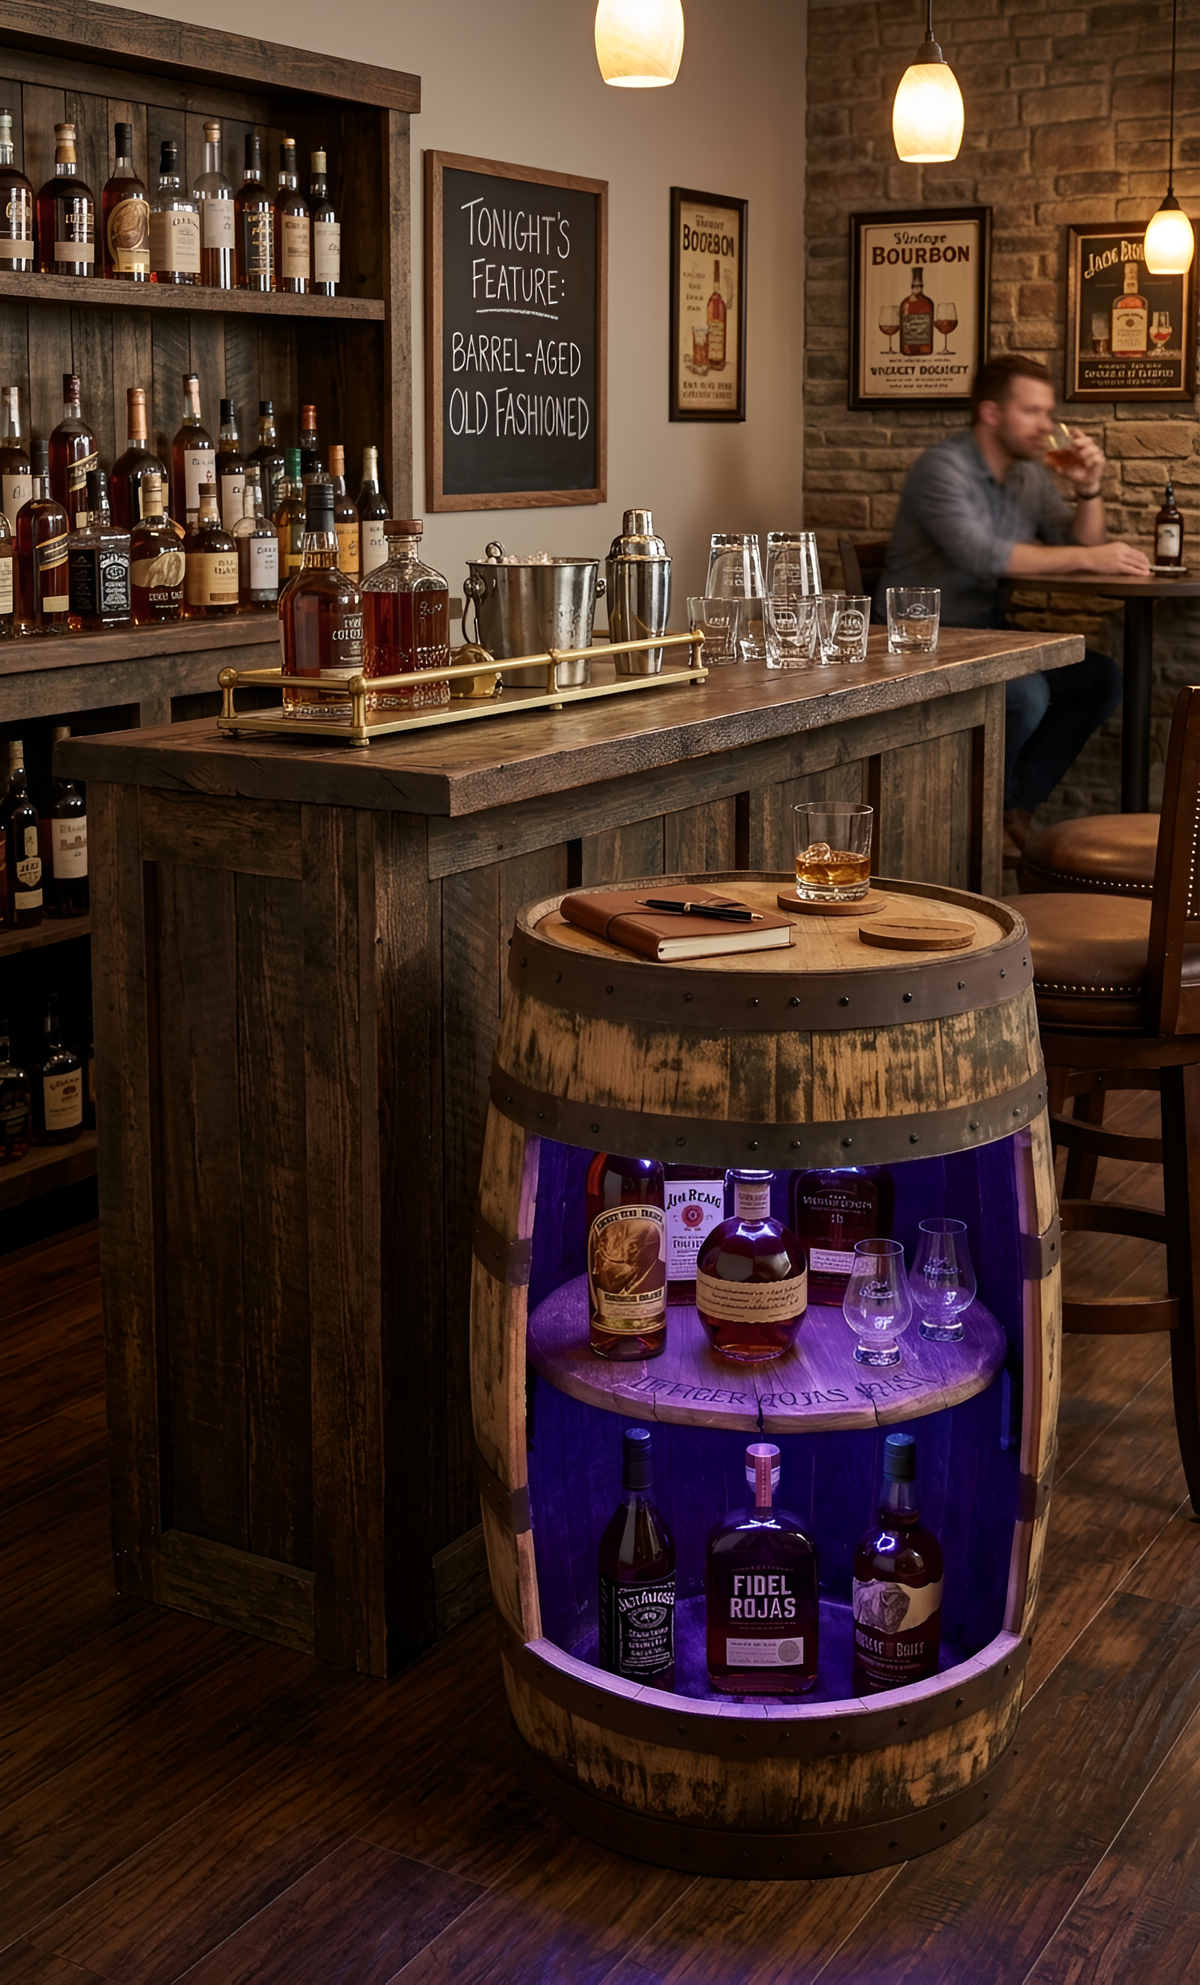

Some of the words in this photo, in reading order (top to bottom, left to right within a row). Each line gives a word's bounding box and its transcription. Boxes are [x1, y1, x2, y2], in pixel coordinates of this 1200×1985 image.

[461, 197, 571, 259] TONIGHT'S
[872, 245, 970, 266] BOURBON
[472, 257, 566, 306] FEATURE:
[451, 331, 582, 377] BARREL-AGED
[449, 387, 488, 436] OLD
[495, 386, 590, 440] FASHIONED
[729, 1597, 797, 1619] ROJAS
[733, 1574, 793, 1596] FIDEL
